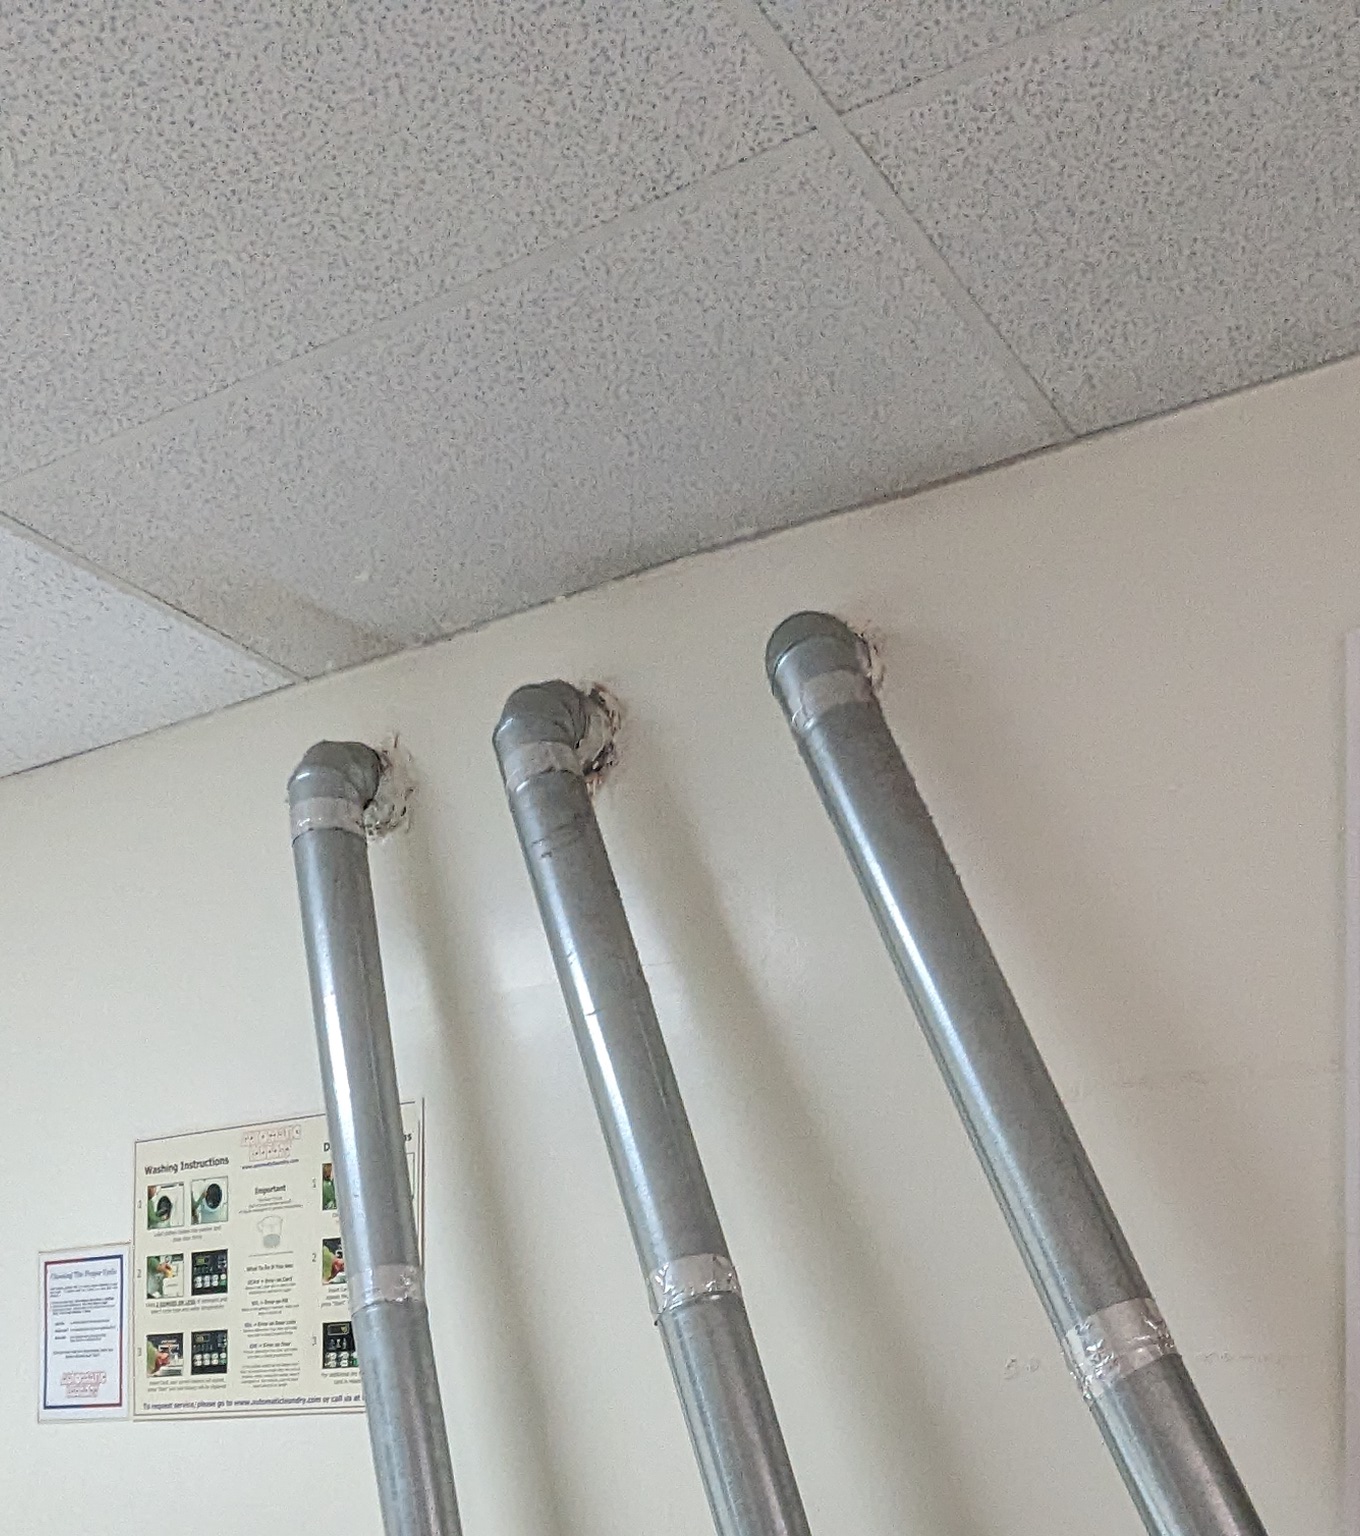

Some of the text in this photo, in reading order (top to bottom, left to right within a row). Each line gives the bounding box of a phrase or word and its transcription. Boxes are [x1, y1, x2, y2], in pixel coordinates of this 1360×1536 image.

[144, 1157, 230, 1175] Washing Instructions
[254, 1184, 287, 1195] Important
